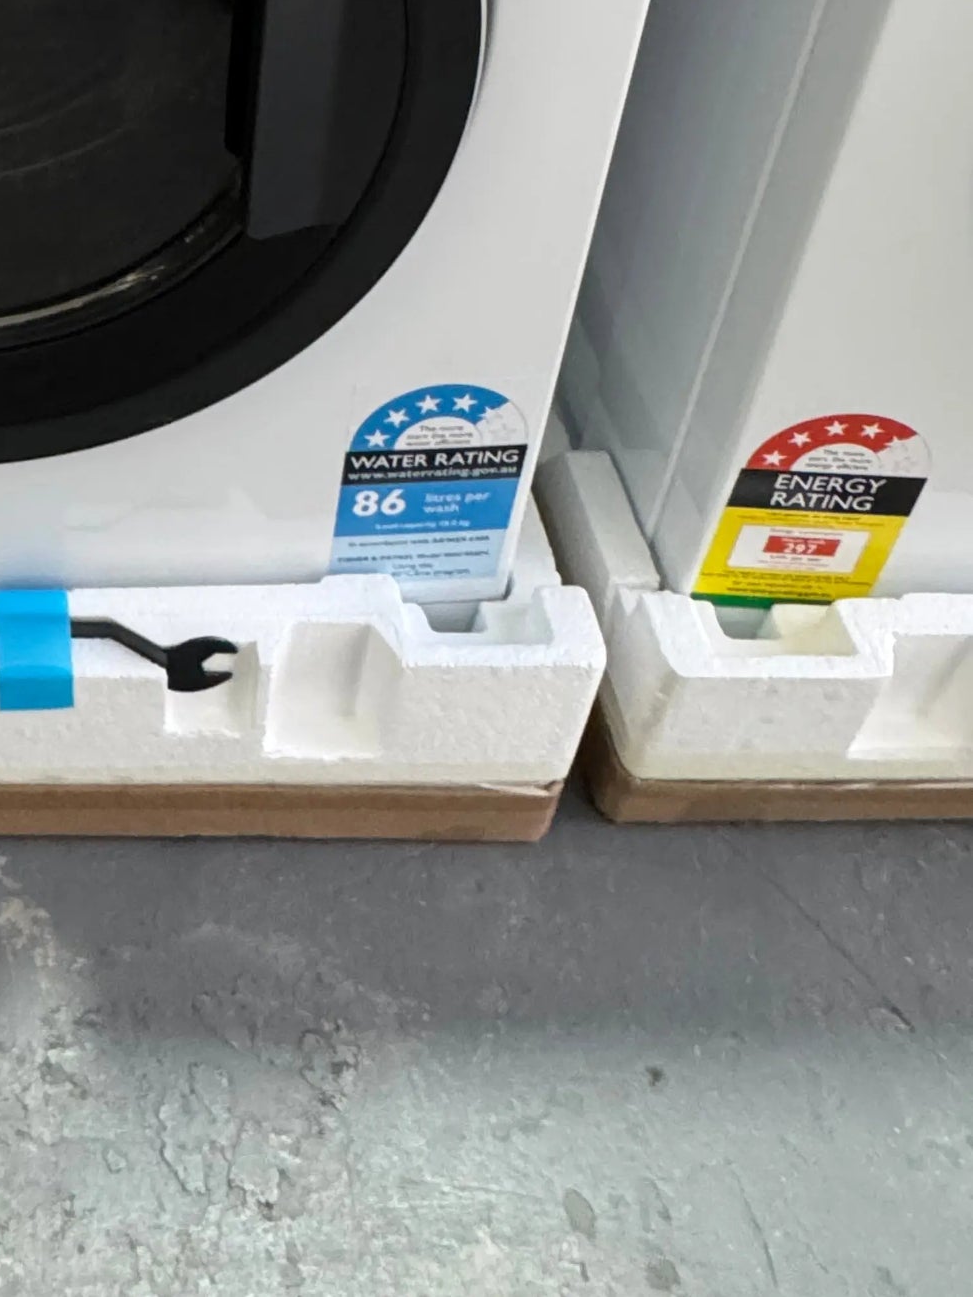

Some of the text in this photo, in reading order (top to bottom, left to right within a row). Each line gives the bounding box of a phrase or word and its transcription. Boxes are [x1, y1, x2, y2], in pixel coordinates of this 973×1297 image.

[350, 449, 519, 470] WATER RATING
[348, 465, 517, 481] www.waterrating.gov.au
[774, 473, 887, 495] ENERGY
[352, 489, 406, 517] 86
[464, 492, 490, 503] per
[770, 492, 875, 512] RATING
[423, 502, 459, 514] wash
[783, 543, 818, 554] 297
